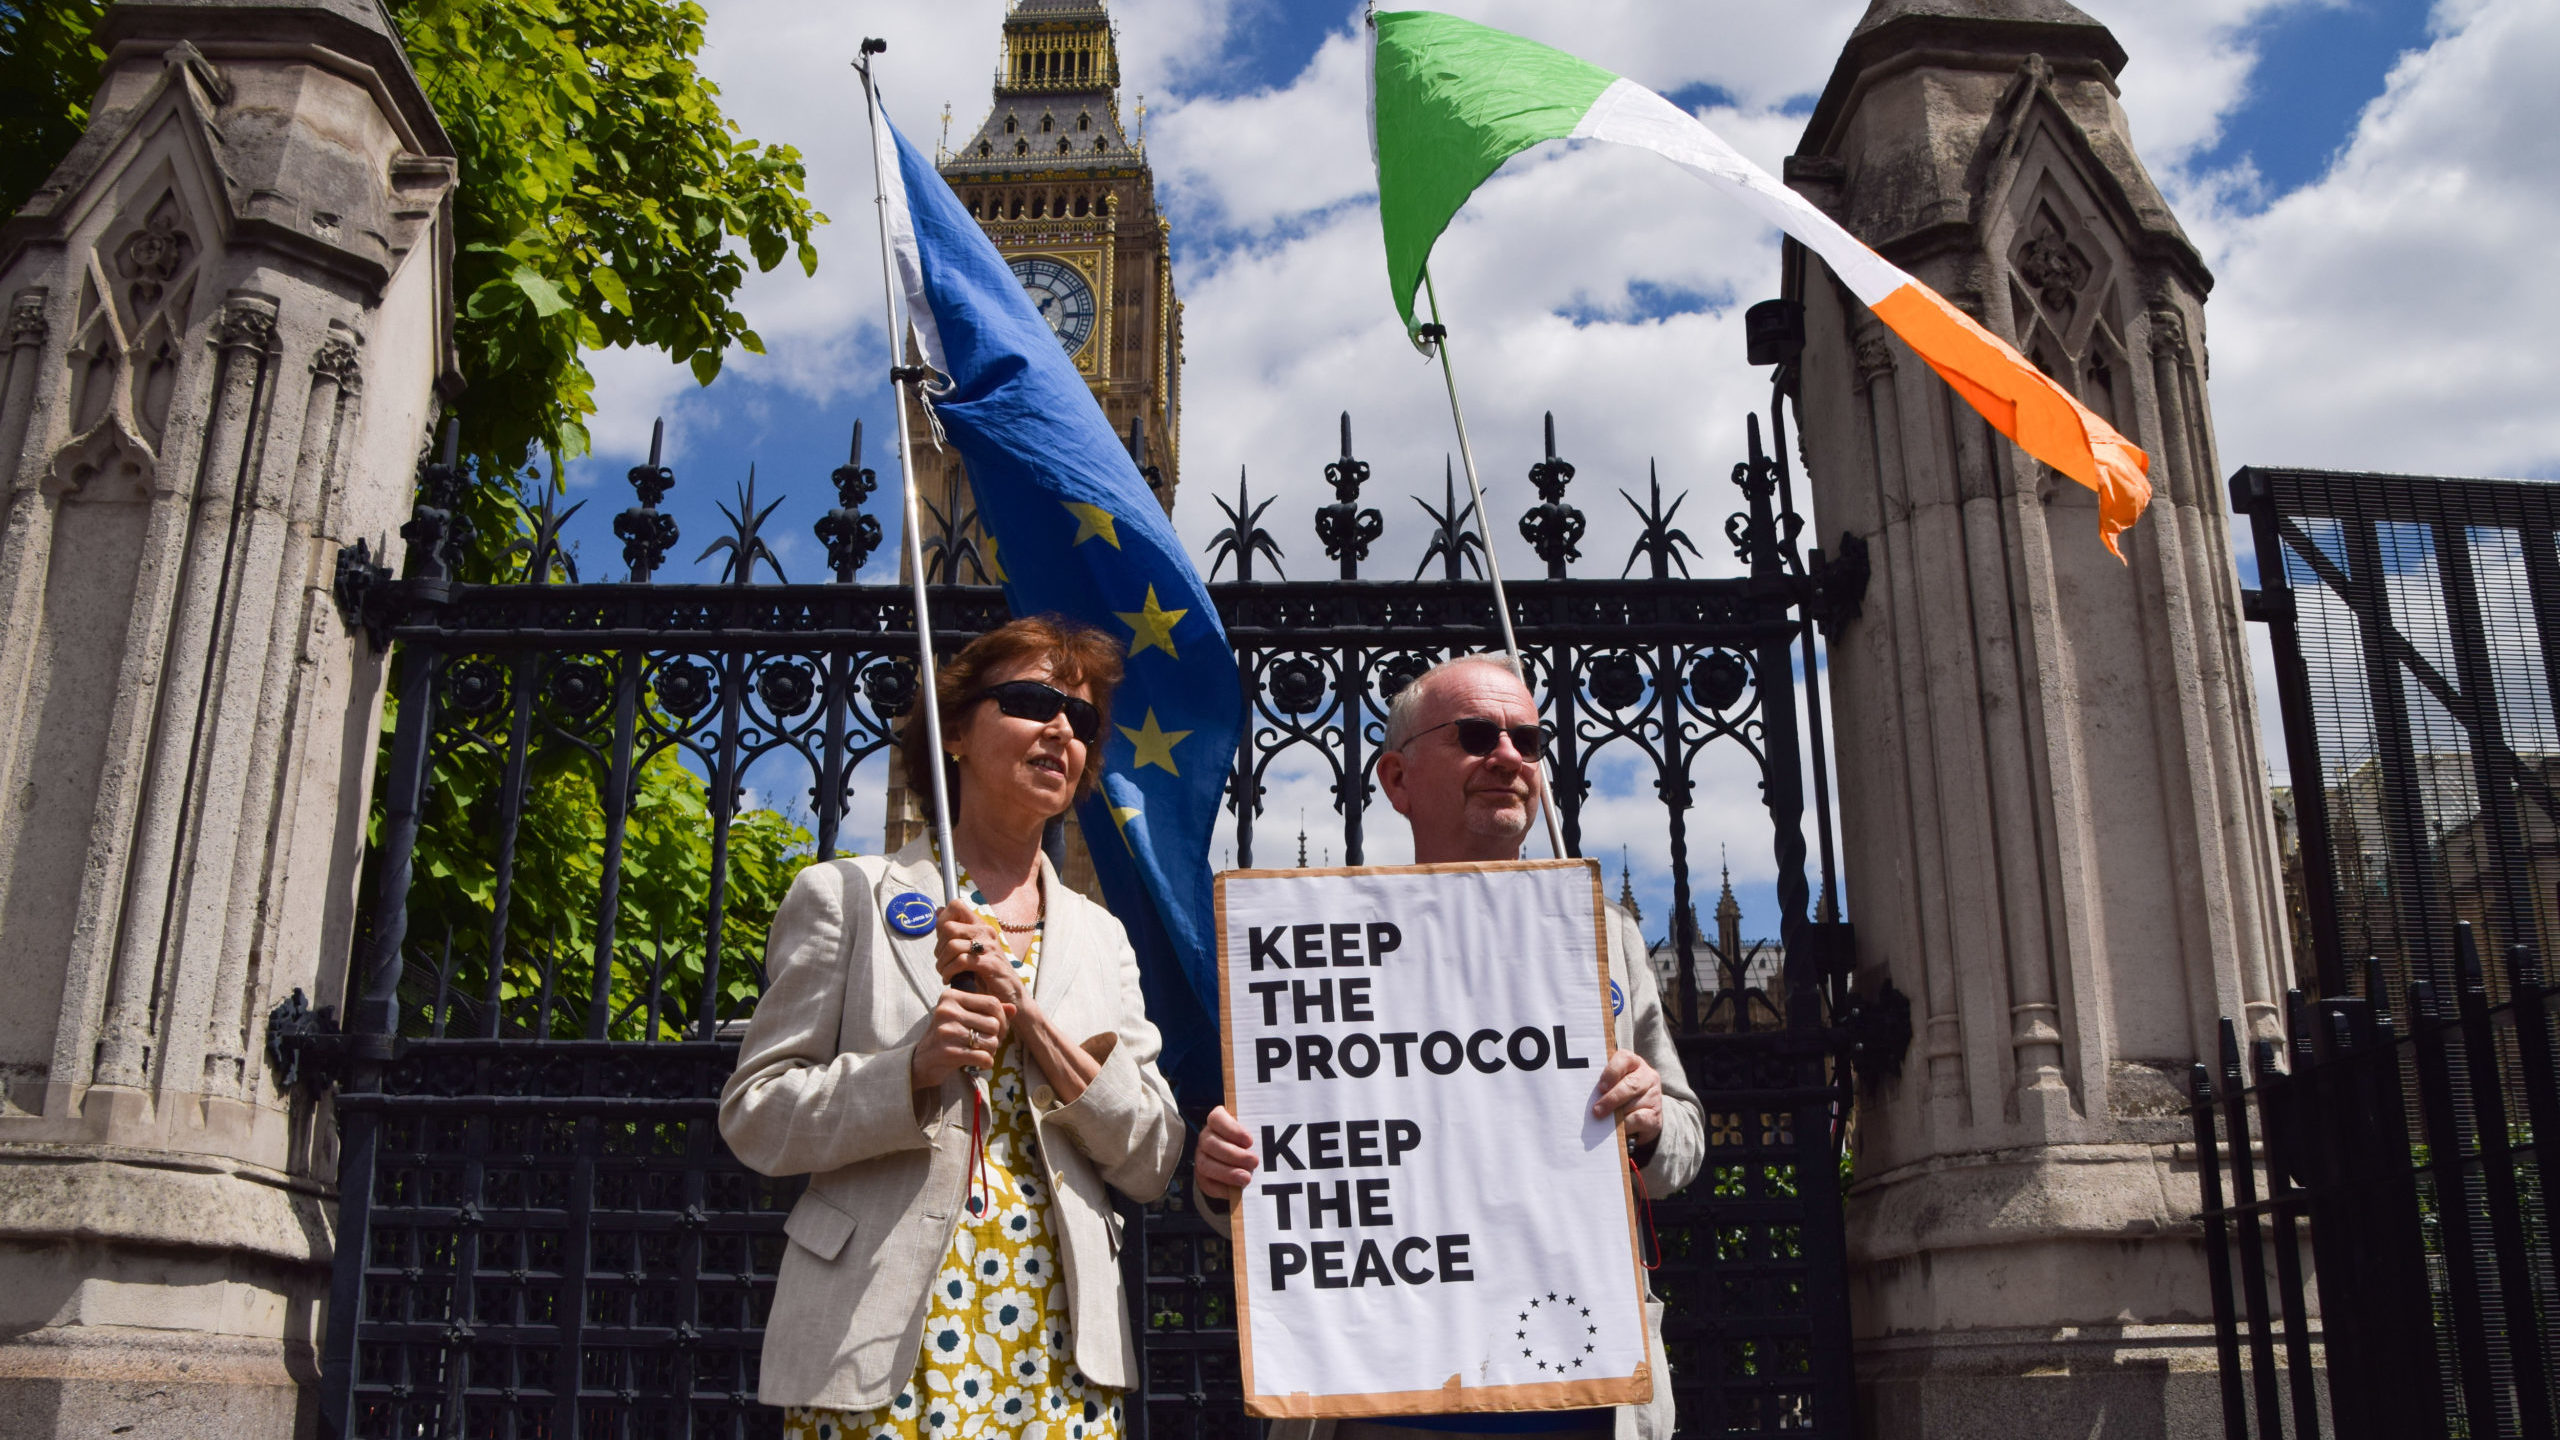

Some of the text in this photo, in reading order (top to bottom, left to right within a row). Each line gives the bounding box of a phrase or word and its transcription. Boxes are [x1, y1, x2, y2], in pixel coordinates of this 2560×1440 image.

[1248, 921, 1402, 972] KEEP
[1248, 977, 1375, 1027] THE
[1255, 1025, 1590, 1084] PROTOCOL
[1260, 1119, 1422, 1173] KEEP
[1261, 1178, 1394, 1231] THE
[1268, 1233, 1475, 1292] PEACE
